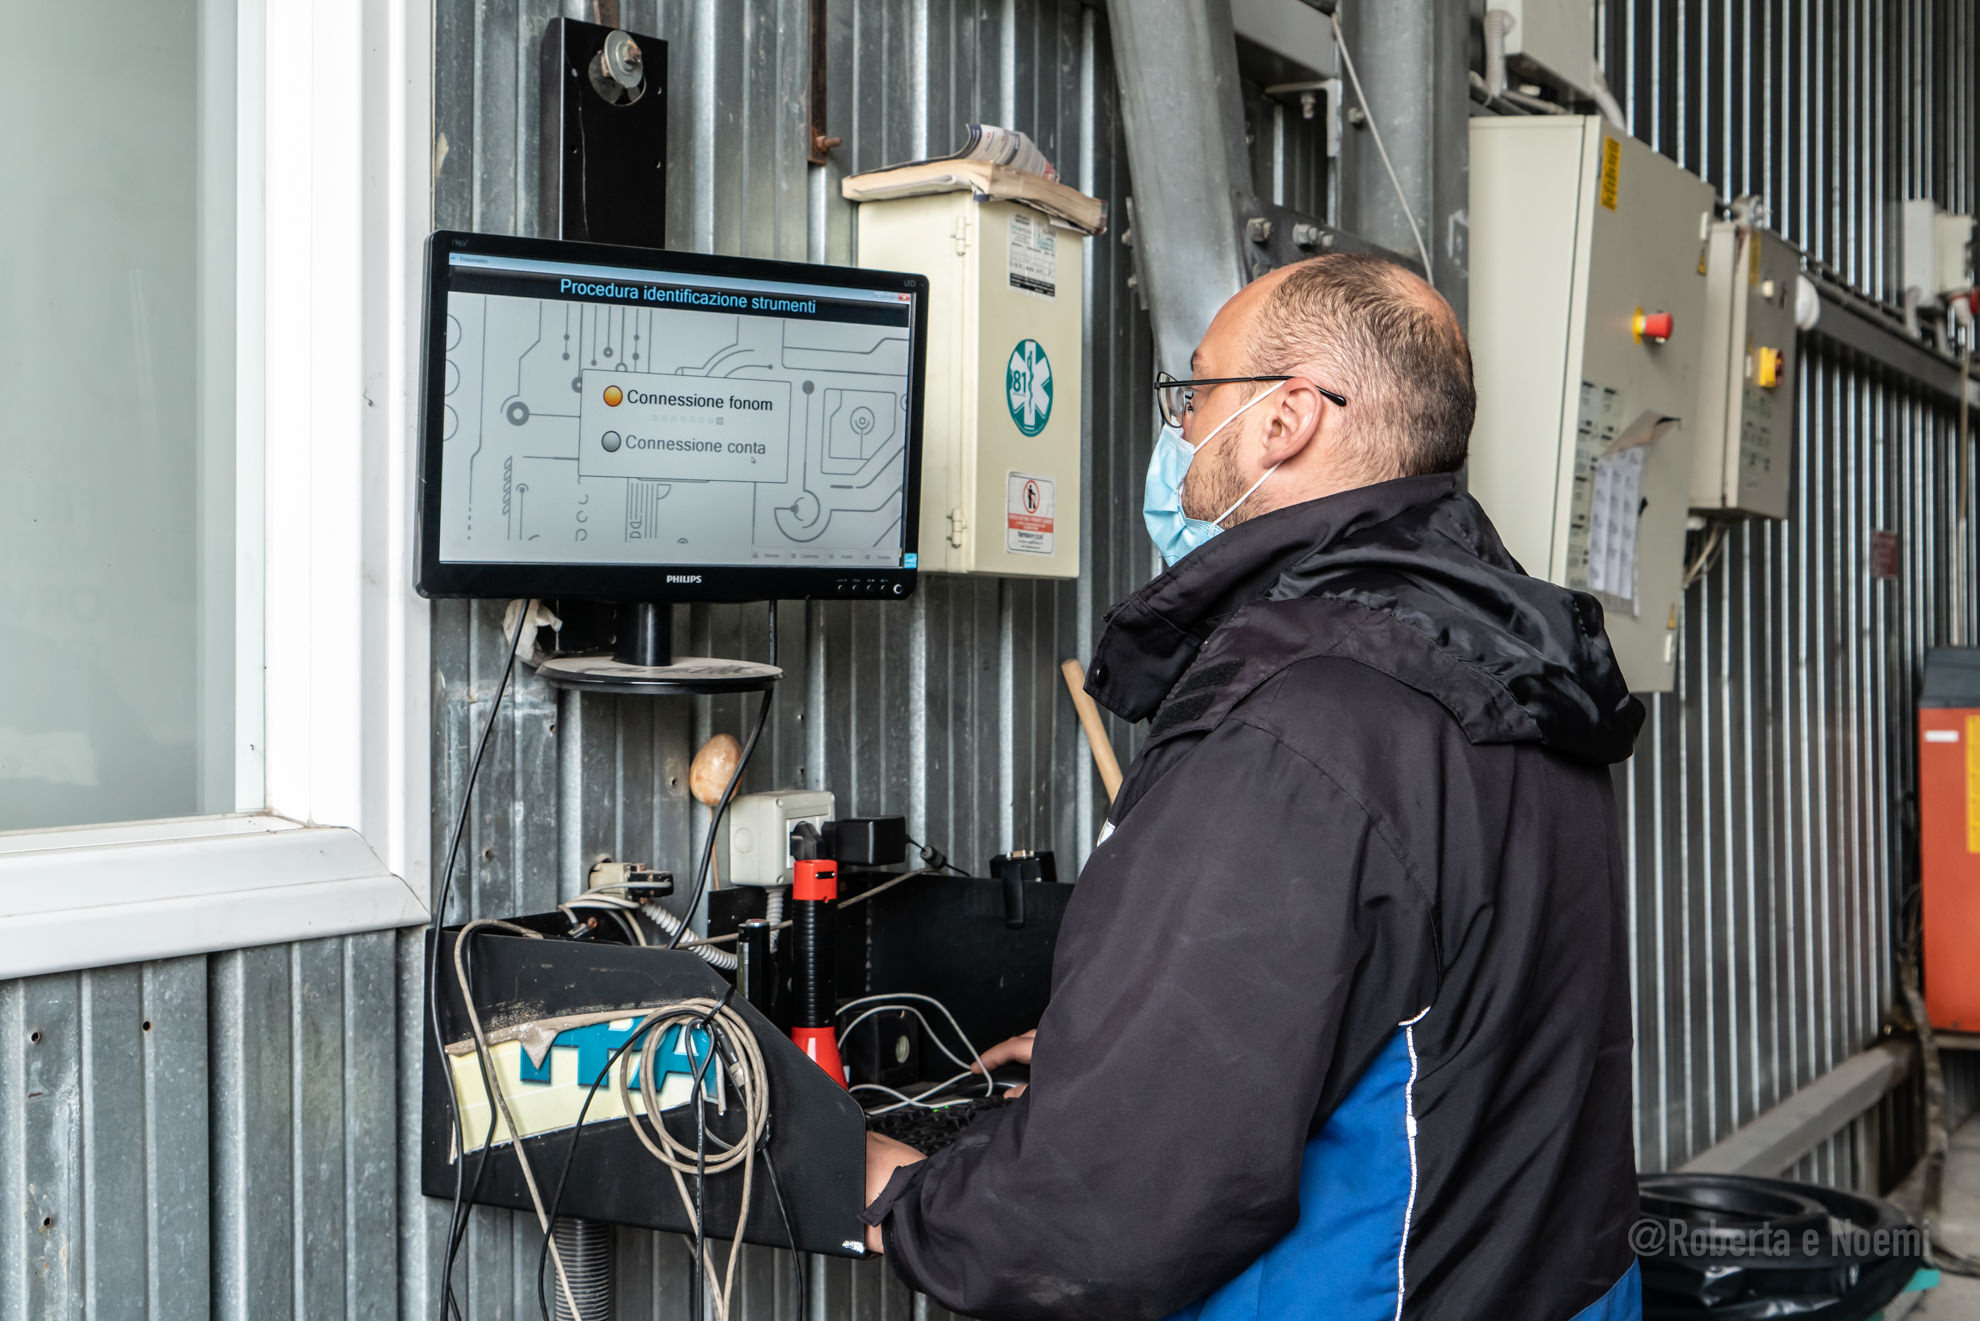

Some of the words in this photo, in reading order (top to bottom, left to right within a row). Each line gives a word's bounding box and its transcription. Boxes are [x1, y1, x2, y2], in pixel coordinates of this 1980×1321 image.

[560, 278, 639, 299] Procedura
[643, 285, 748, 308] identificazione
[751, 296, 816, 314] strumenti
[627, 389, 724, 409] Connessione
[729, 395, 773, 411] fonom
[625, 434, 722, 453] Connessione
[727, 441, 766, 455] conta
[667, 575, 702, 584] PHILIPS
